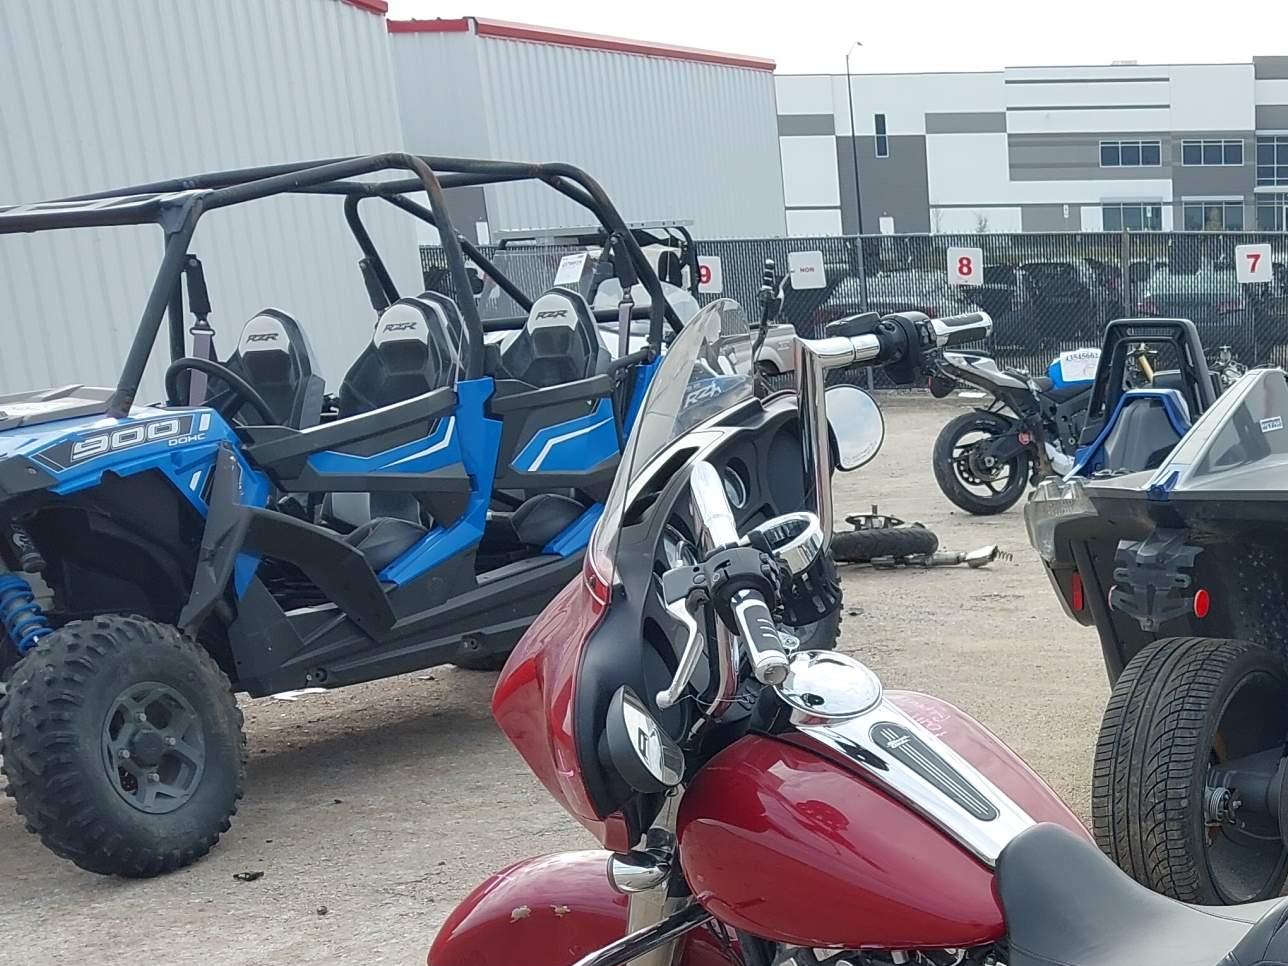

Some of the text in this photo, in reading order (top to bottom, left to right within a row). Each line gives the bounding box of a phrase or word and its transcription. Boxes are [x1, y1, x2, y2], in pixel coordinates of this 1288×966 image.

[958, 256, 973, 276] 8
[1247, 253, 1261, 273] 7
[700, 265, 711, 284] 9
[535, 310, 568, 321] RZR
[382, 322, 417, 334] RZR
[246, 333, 279, 344] RZR
[71, 418, 180, 462] 900
[168, 433, 206, 447] DOHC
